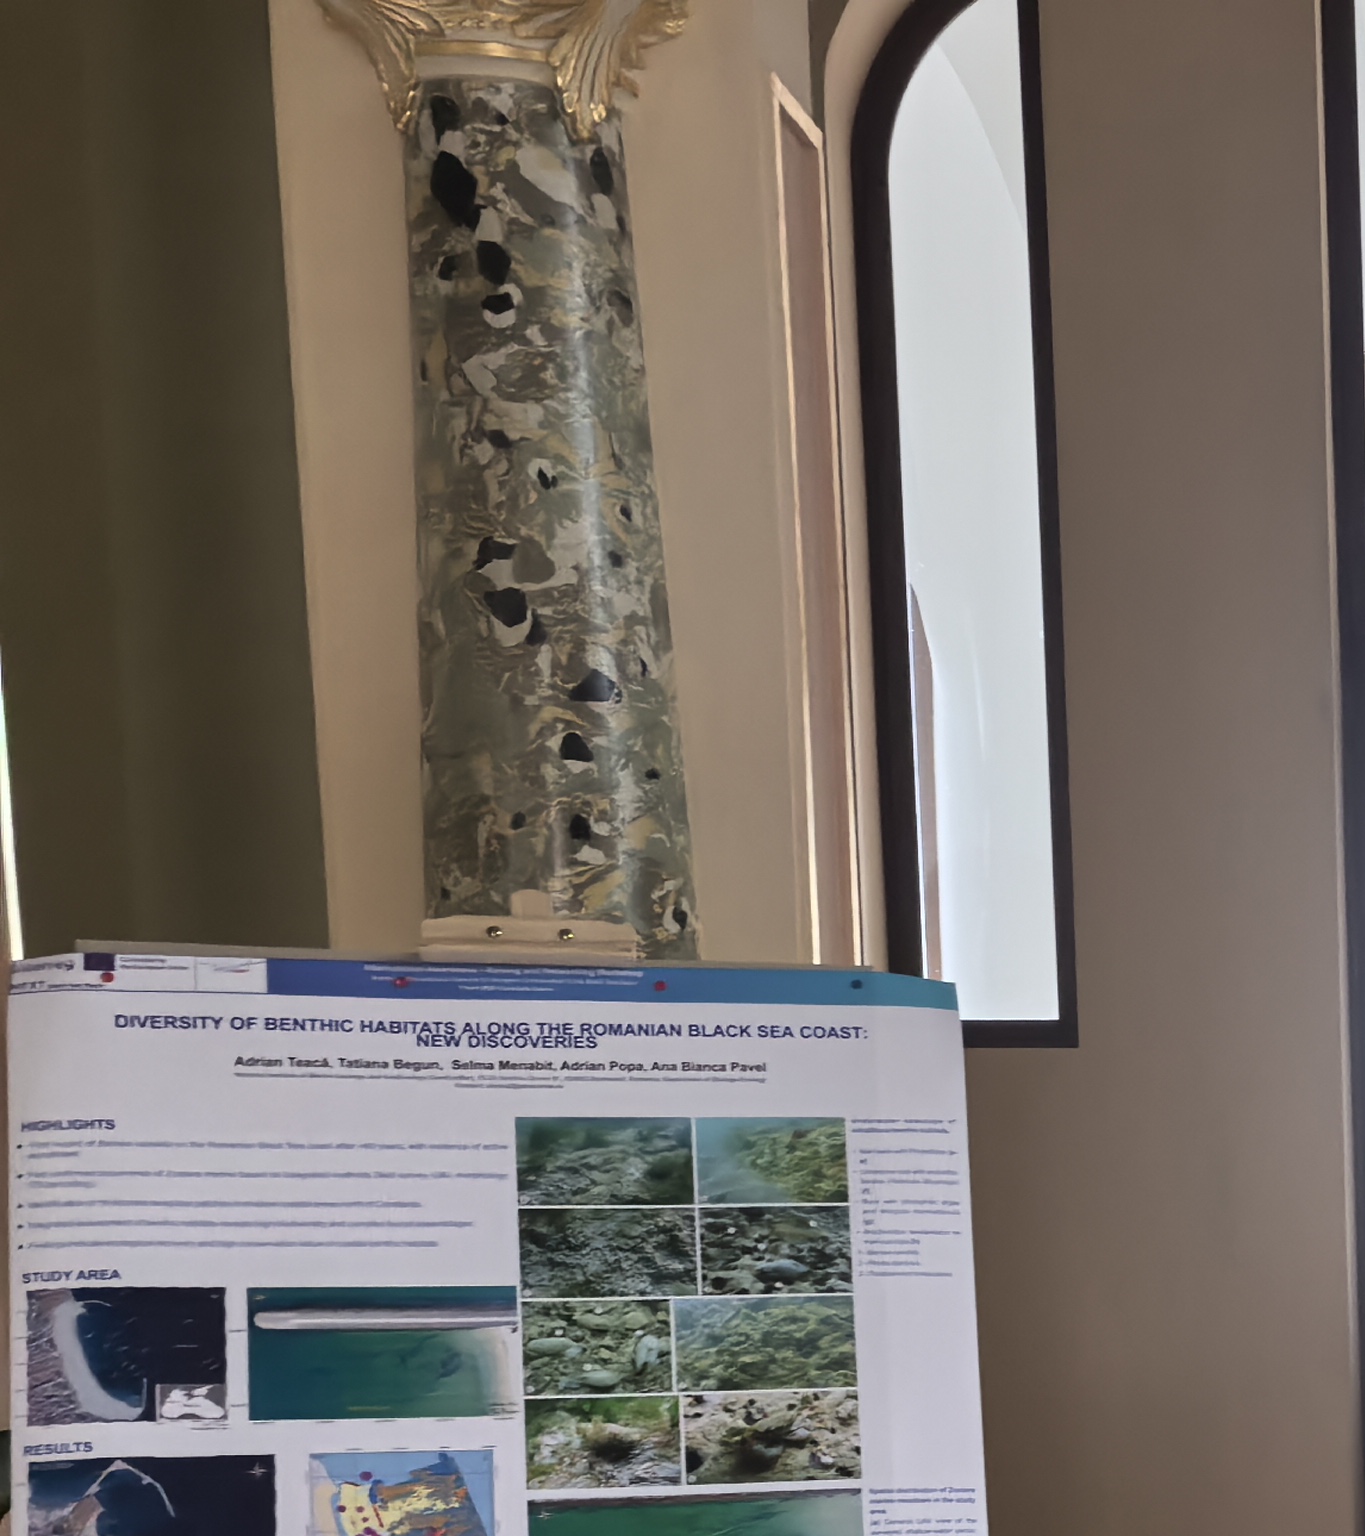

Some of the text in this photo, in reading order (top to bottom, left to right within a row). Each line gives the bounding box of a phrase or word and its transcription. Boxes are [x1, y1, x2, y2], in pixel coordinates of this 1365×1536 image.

[115, 1014, 867, 1040] DIVERSITY OF BENTHIC HABITATS ALONG THE ROMANIAN BLACK SEA COAST:
[417, 1034, 598, 1049] NEW DISCOVERIES
[234, 1056, 283, 1067] Adrian
[337, 1058, 389, 1069] Tatiana
[560, 1061, 605, 1071] Adrian
[650, 1062, 677, 1071] Ana
[681, 1062, 727, 1072] Bianca
[730, 1062, 766, 1072] Pavel
[21, 1119, 116, 1132] HIGHLIGHTS
[22, 1269, 121, 1284] STUDY AREA
[23, 1442, 93, 1456] RESULTS
